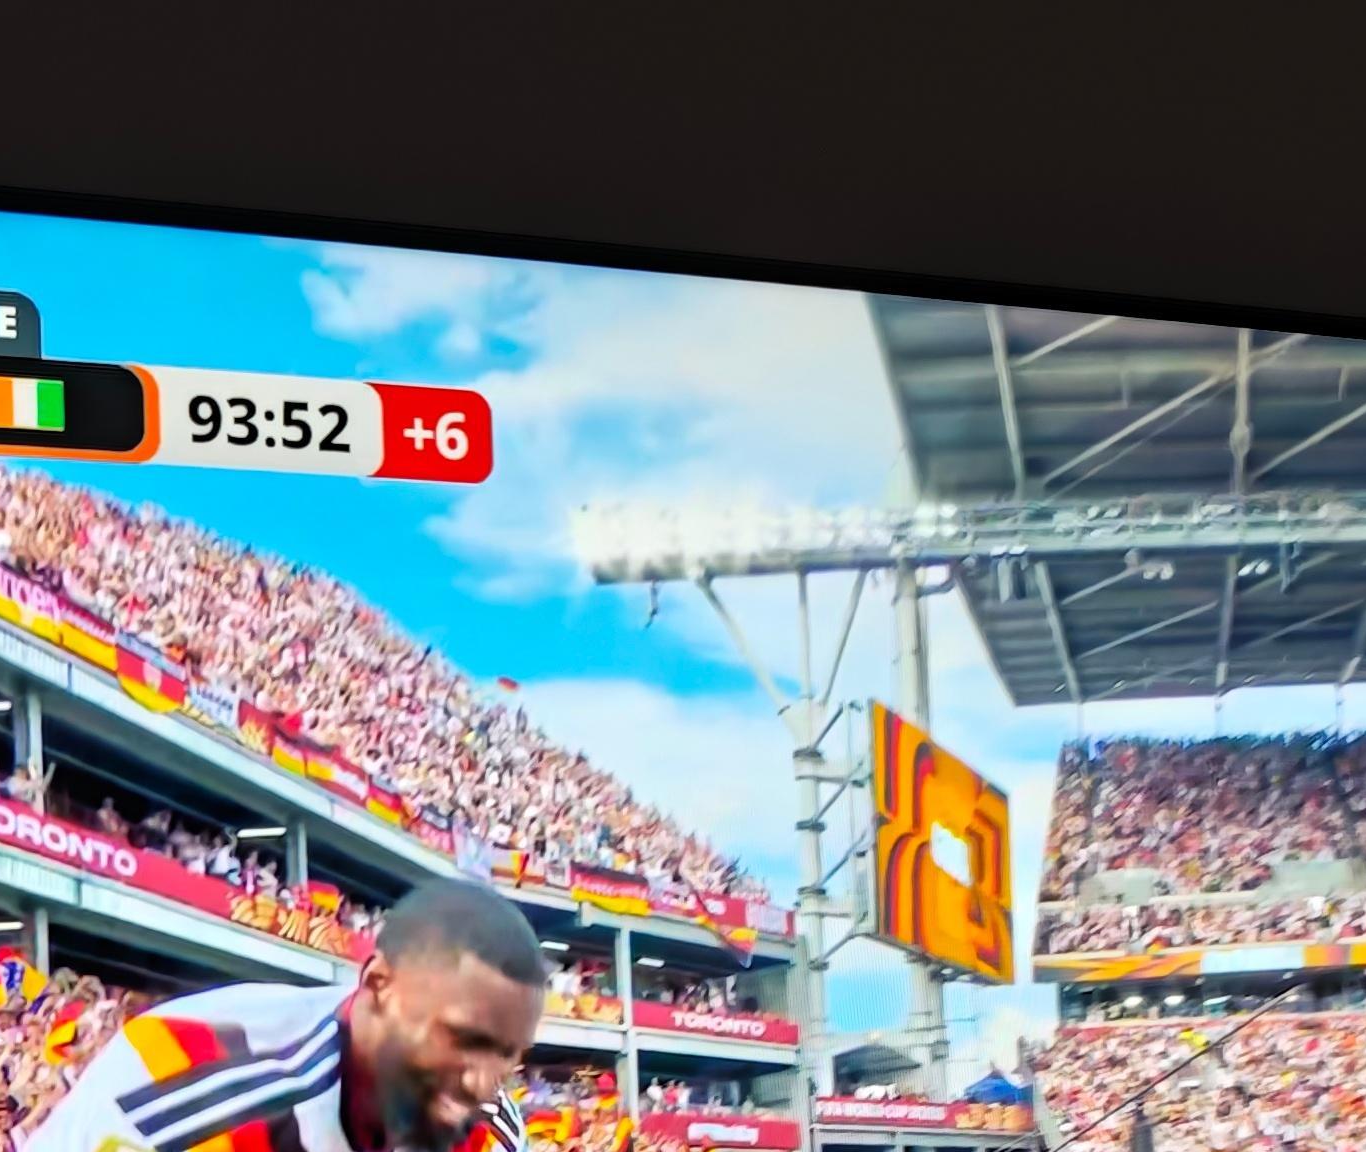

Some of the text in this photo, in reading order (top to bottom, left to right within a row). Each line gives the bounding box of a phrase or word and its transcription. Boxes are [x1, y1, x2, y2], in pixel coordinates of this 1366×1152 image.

[188, 395, 351, 453] 93:52
[403, 410, 469, 461] +6
[669, 1010, 768, 1038] TORONTO
